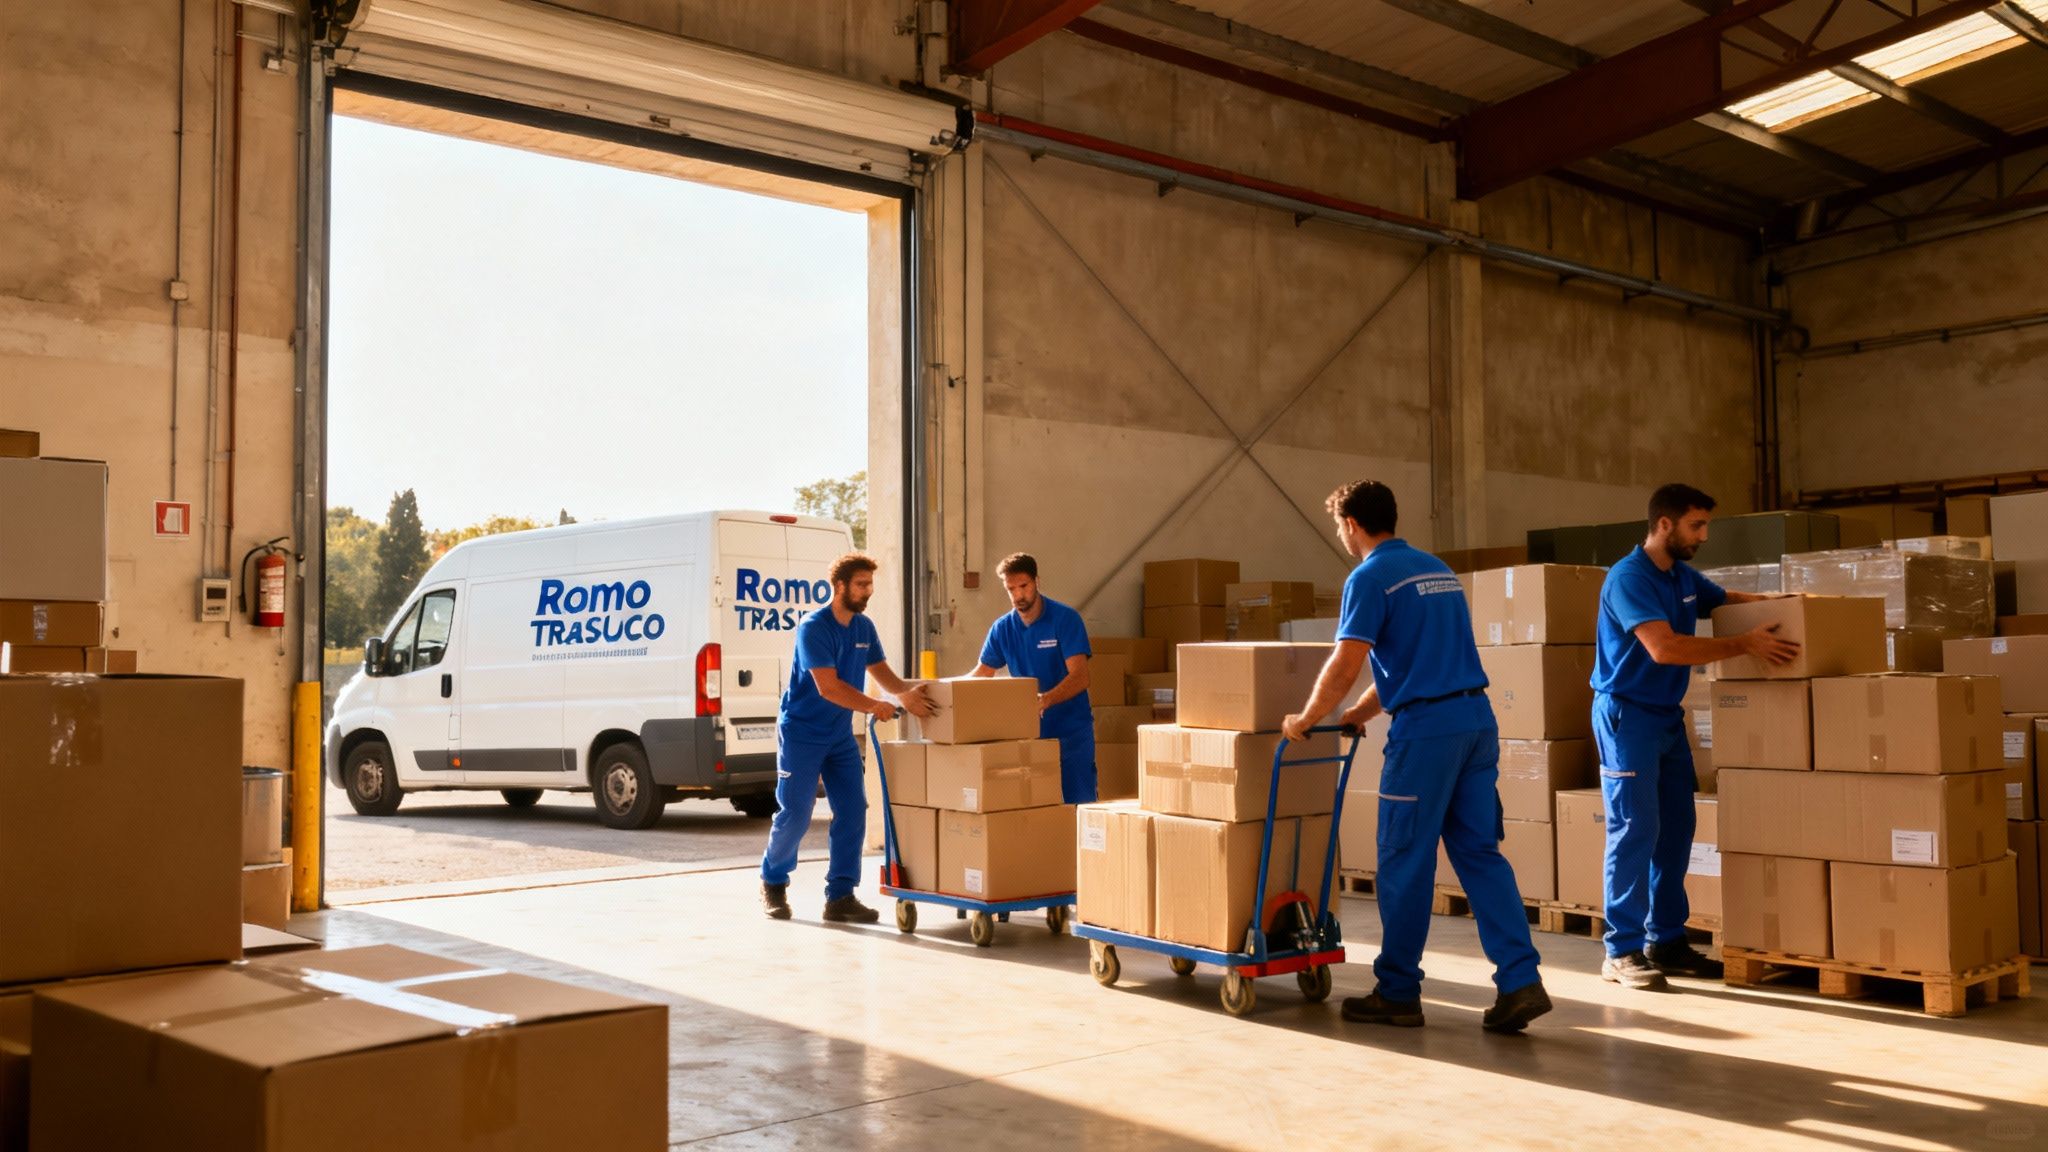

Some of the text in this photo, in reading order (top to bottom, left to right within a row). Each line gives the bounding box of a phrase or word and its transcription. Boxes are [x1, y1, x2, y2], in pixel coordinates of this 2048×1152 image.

[535, 579, 652, 616] Romo
[736, 568, 832, 605] Romo
[530, 613, 665, 647] TRASUCO
